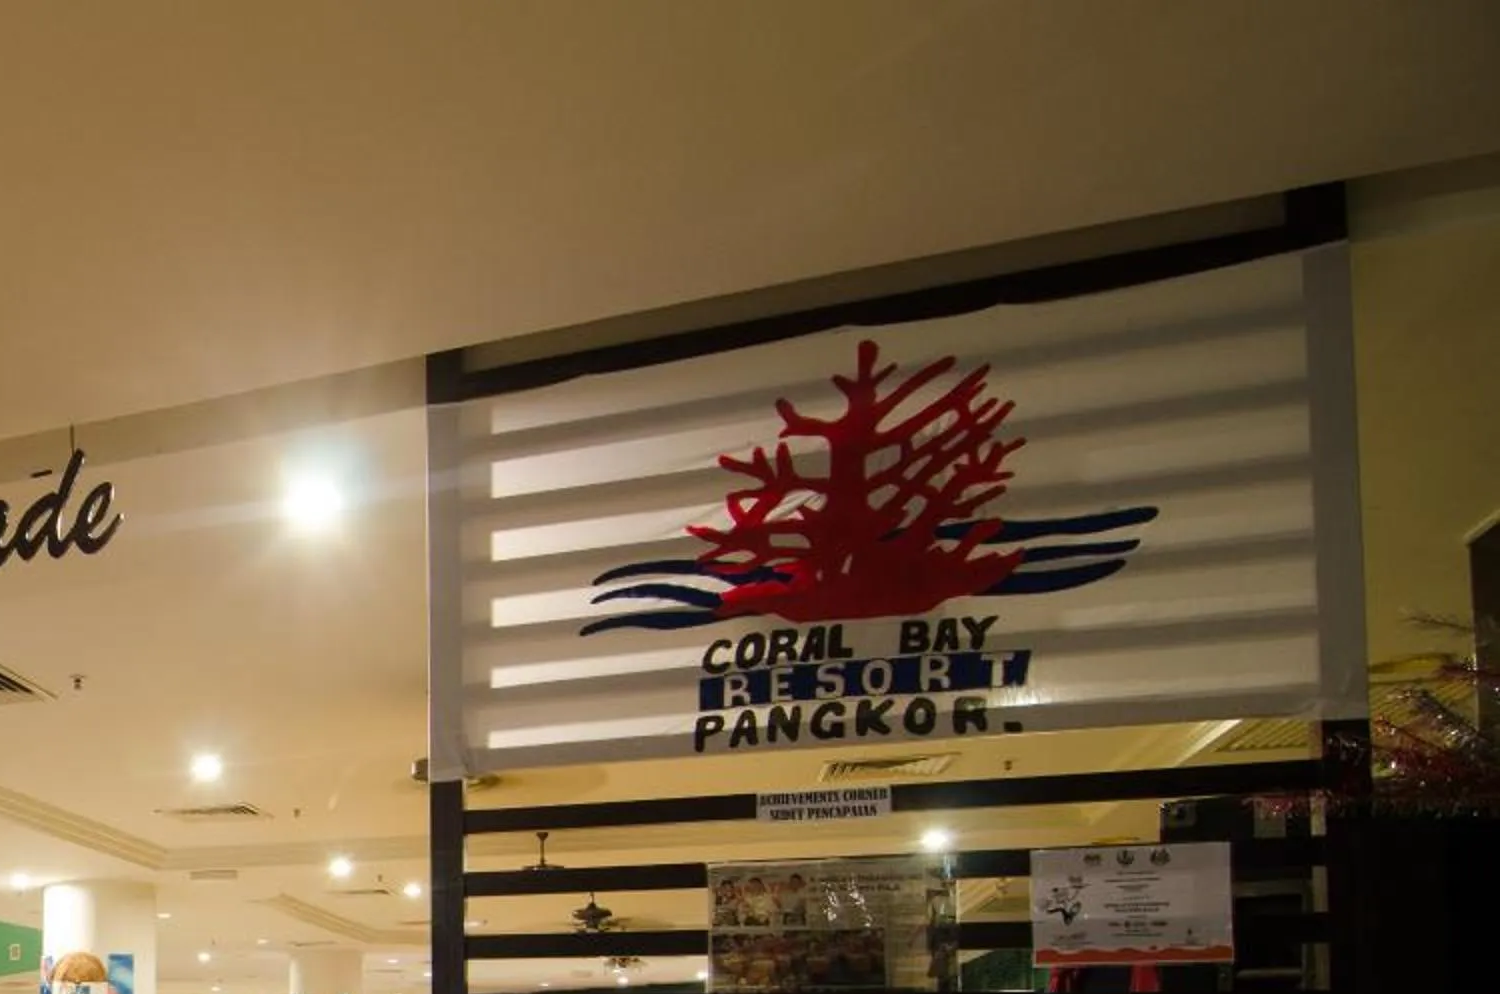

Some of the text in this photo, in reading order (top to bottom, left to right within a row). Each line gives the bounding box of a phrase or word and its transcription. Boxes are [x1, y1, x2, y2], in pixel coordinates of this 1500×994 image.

[703, 615, 999, 674] CORAL BAY
[723, 654, 1016, 708] RESORT
